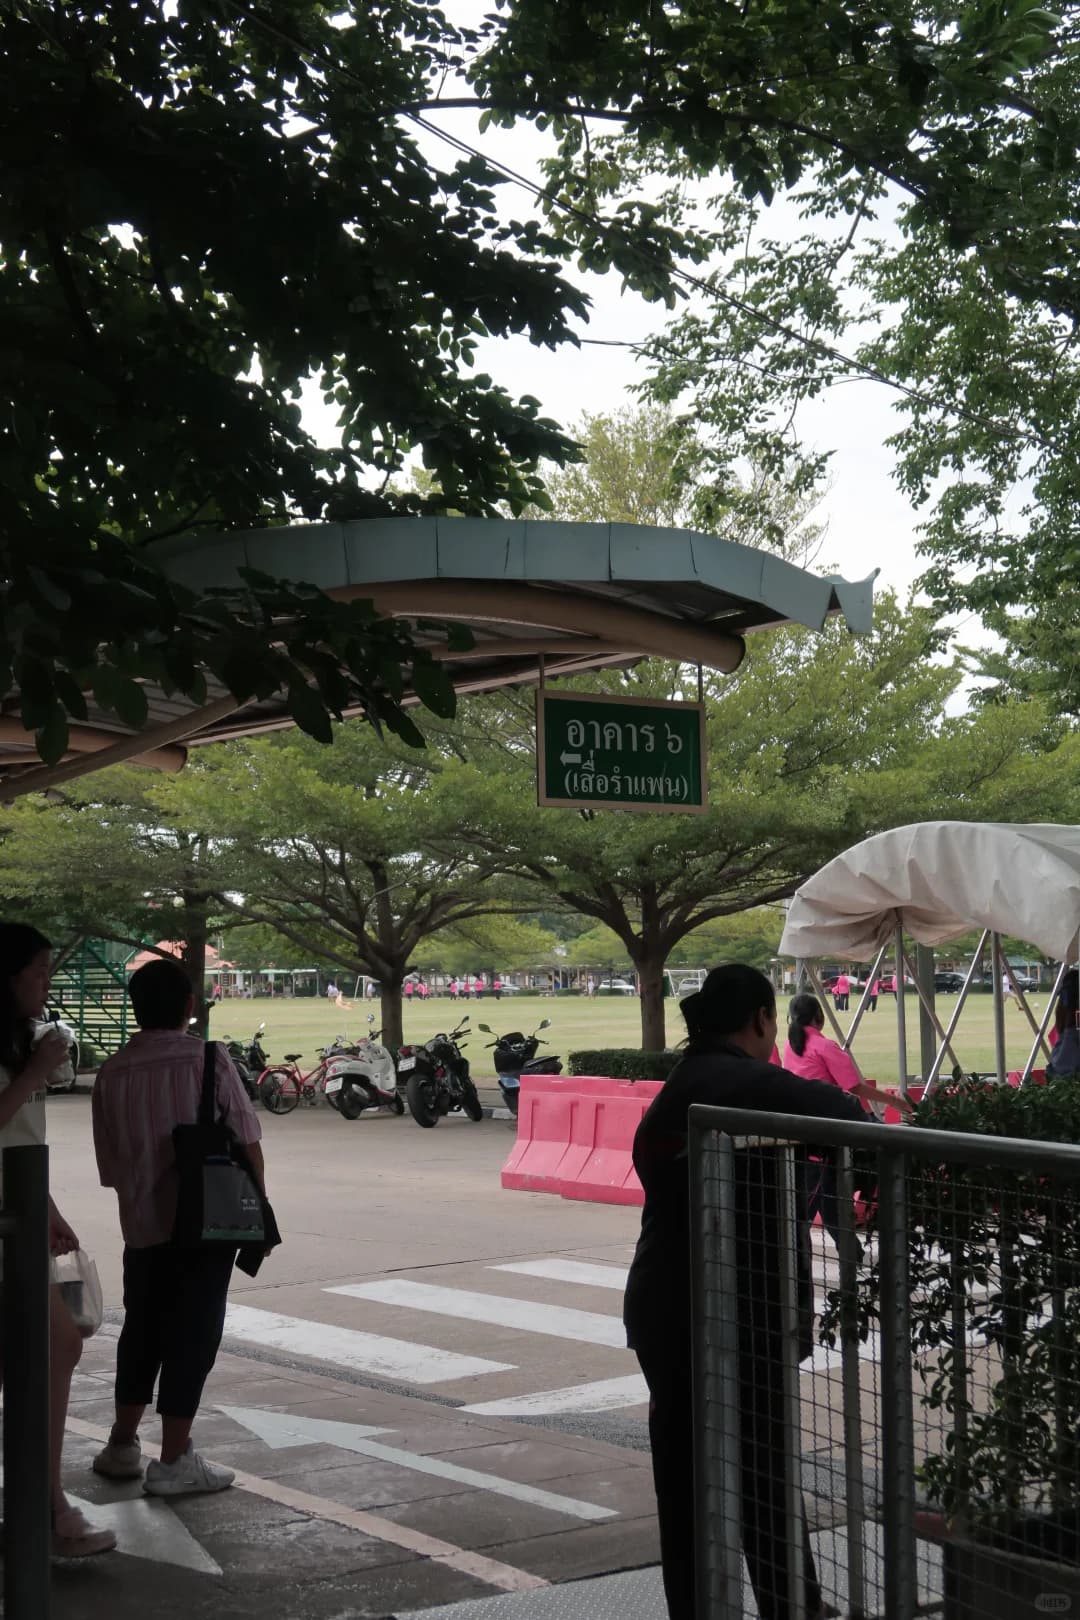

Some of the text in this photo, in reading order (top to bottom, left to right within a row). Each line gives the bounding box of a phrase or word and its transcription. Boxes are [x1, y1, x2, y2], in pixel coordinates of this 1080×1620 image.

[566, 719, 683, 754] อาคาร ๖
[565, 750, 689, 800] (เสื่อรำแพน)
